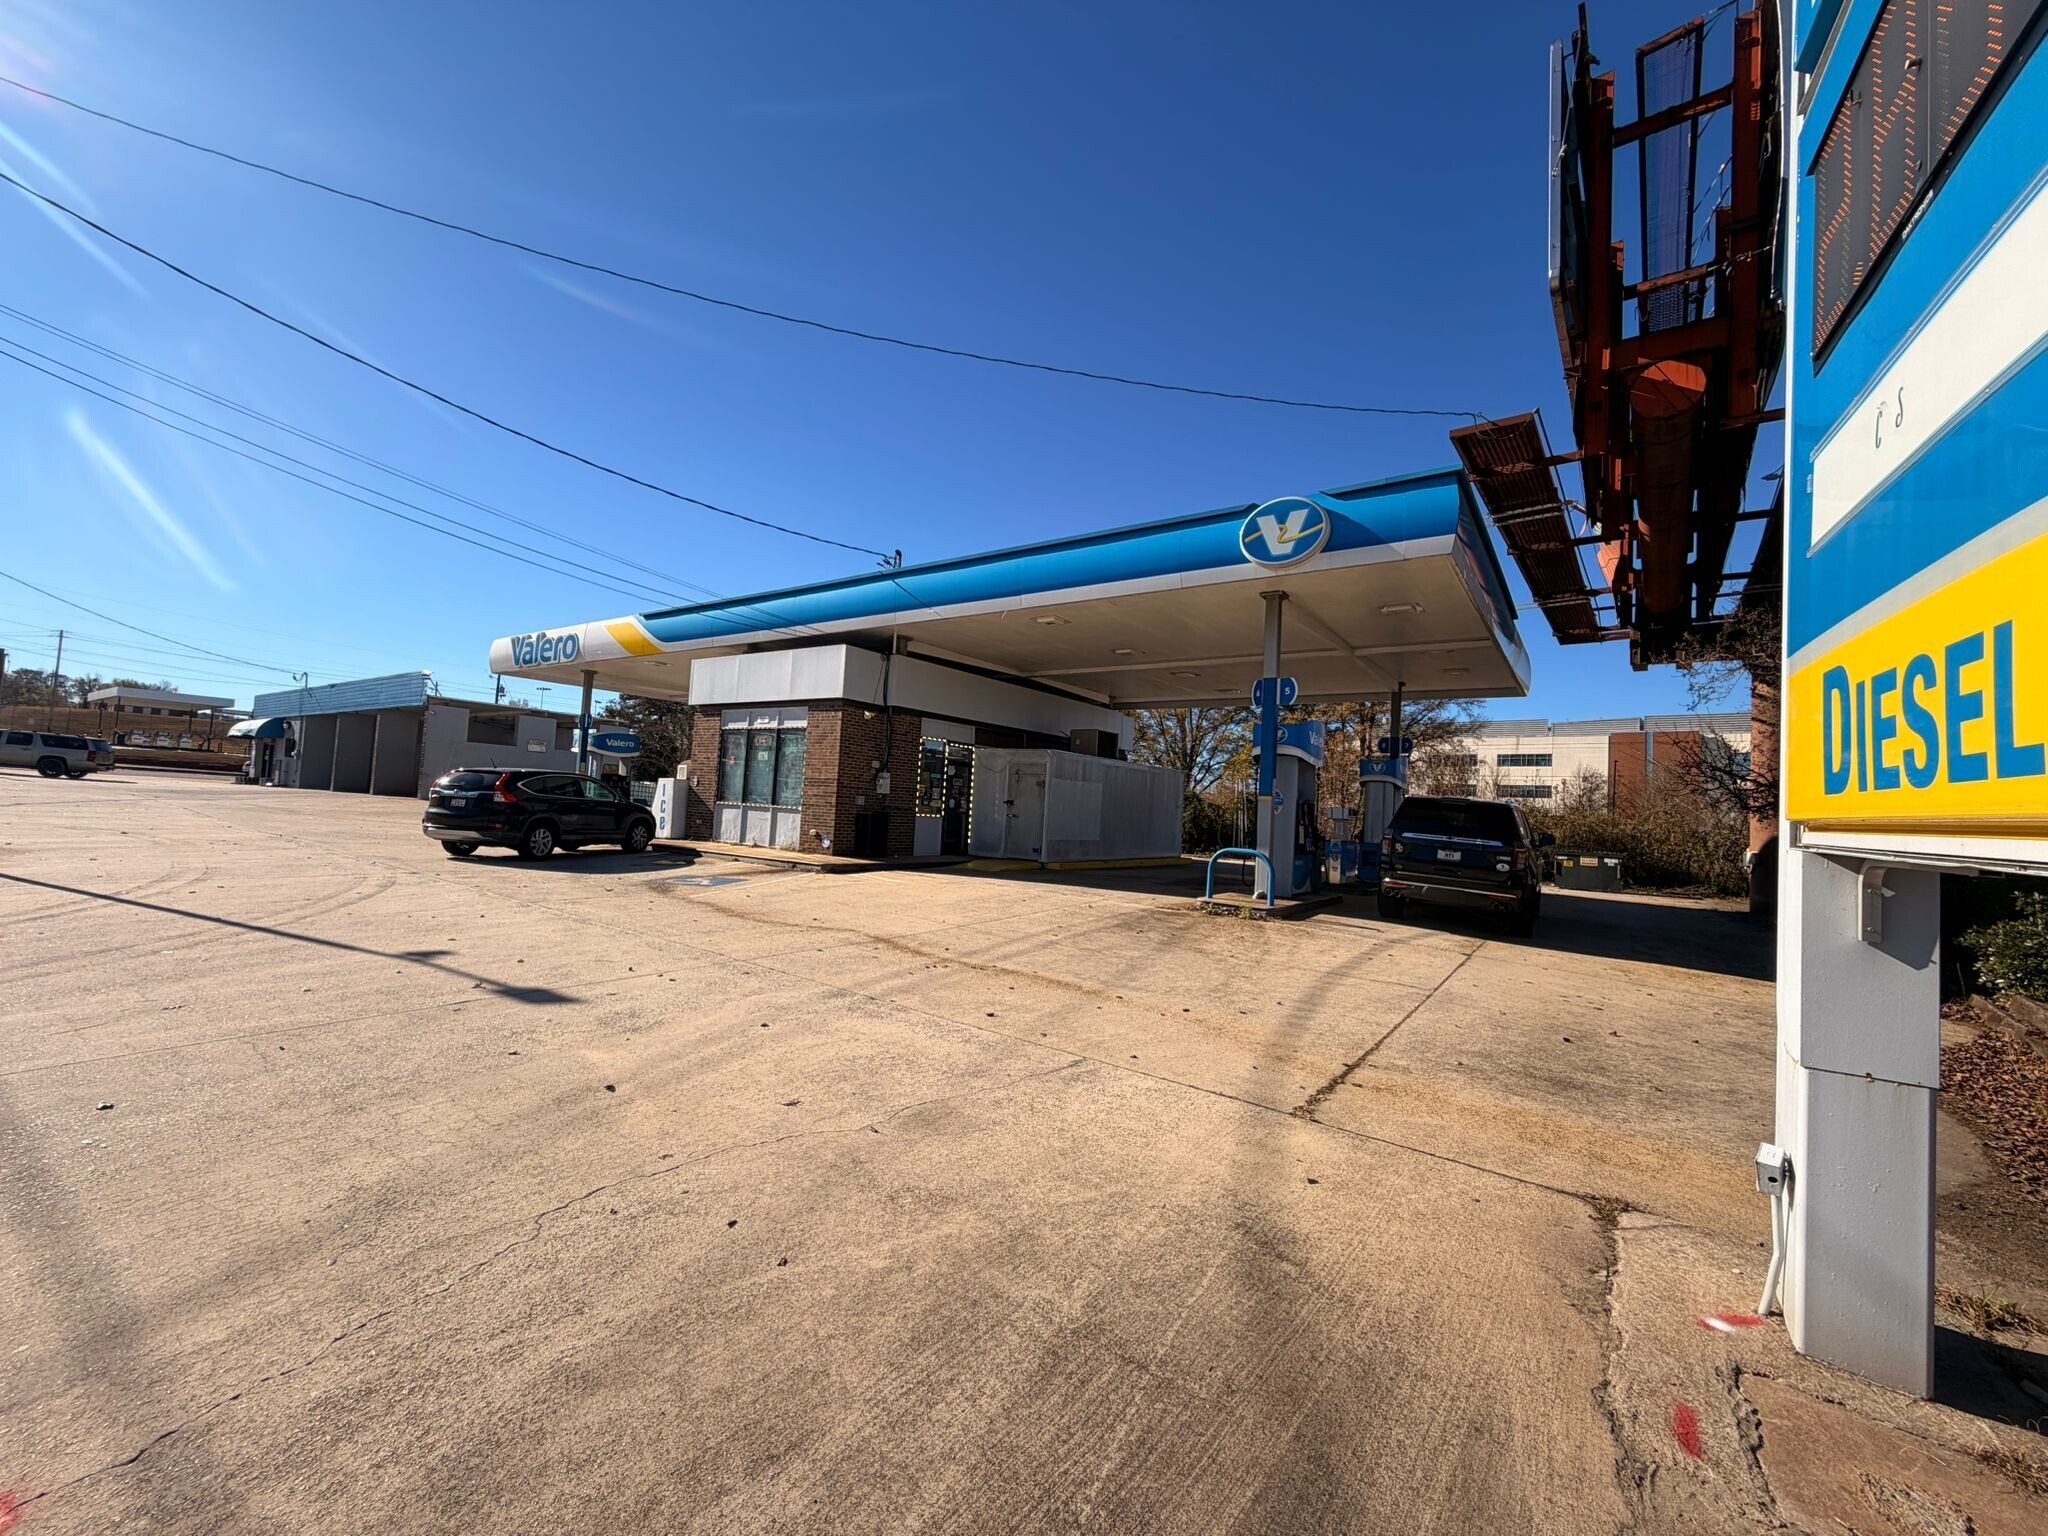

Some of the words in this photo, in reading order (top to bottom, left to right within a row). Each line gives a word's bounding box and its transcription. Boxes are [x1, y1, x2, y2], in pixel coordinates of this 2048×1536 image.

[511, 632, 579, 667] Valero
[1284, 687, 1291, 695] 5
[1822, 619, 2046, 796] DIESEL
[606, 738, 635, 748] Valero
